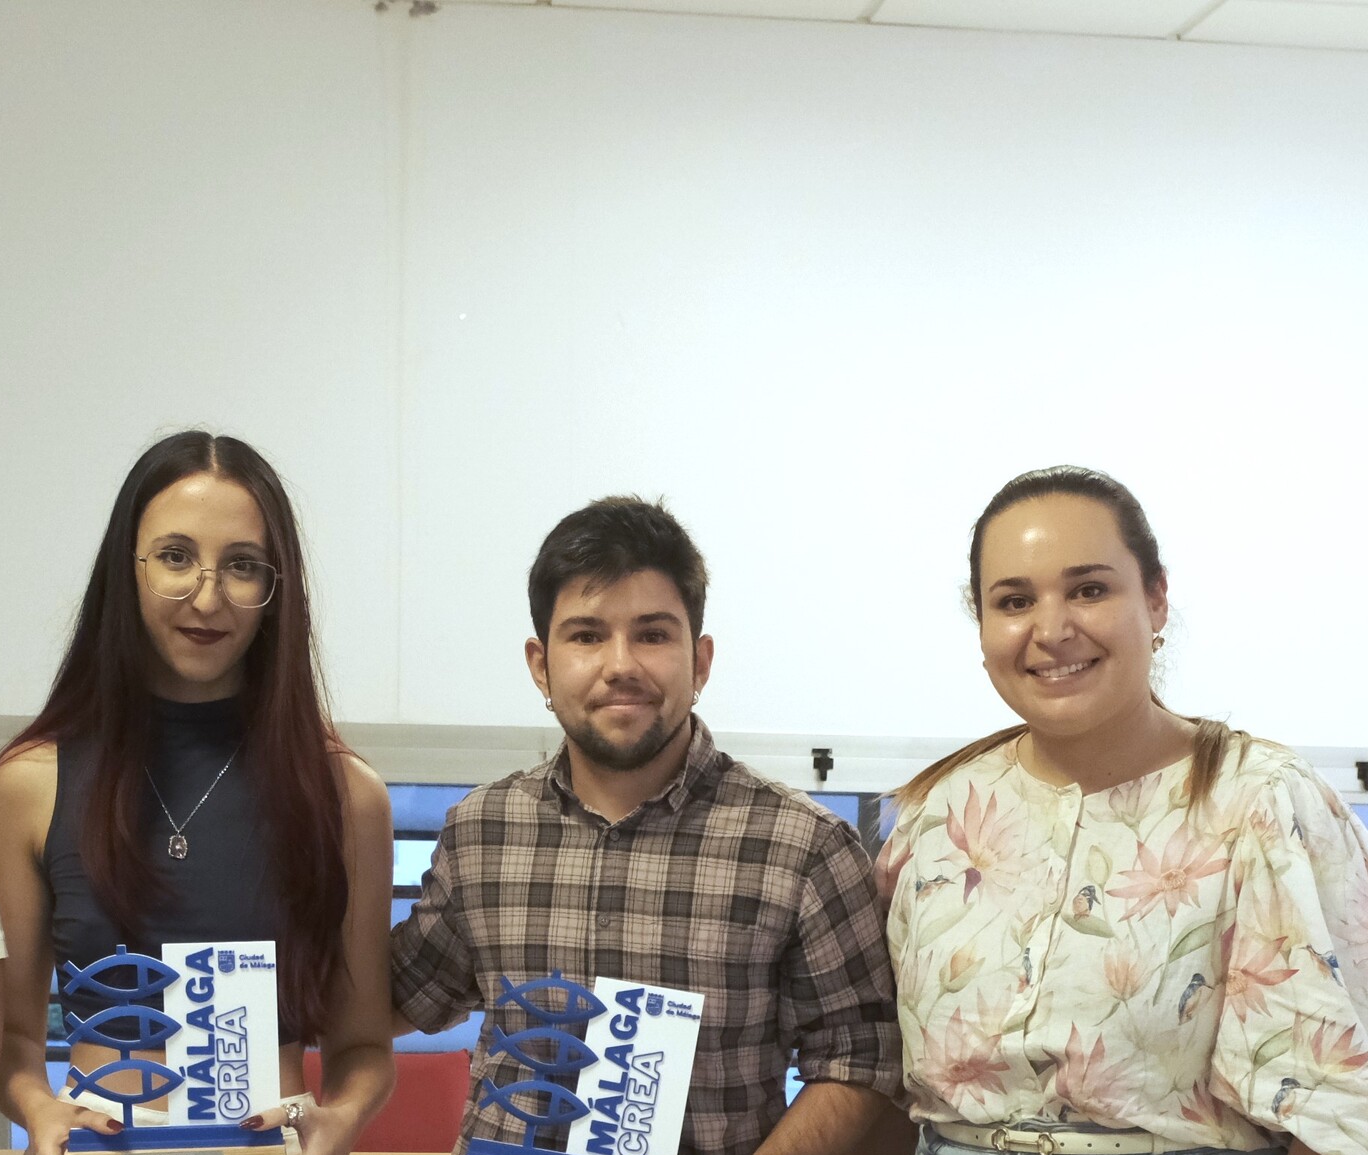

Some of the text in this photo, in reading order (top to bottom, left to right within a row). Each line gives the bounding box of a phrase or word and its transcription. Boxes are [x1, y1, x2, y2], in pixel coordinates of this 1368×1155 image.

[179, 946, 216, 1121] MÁLAGA
[216, 1006, 250, 1120] CREA
[586, 988, 645, 1155] MÁLAGA
